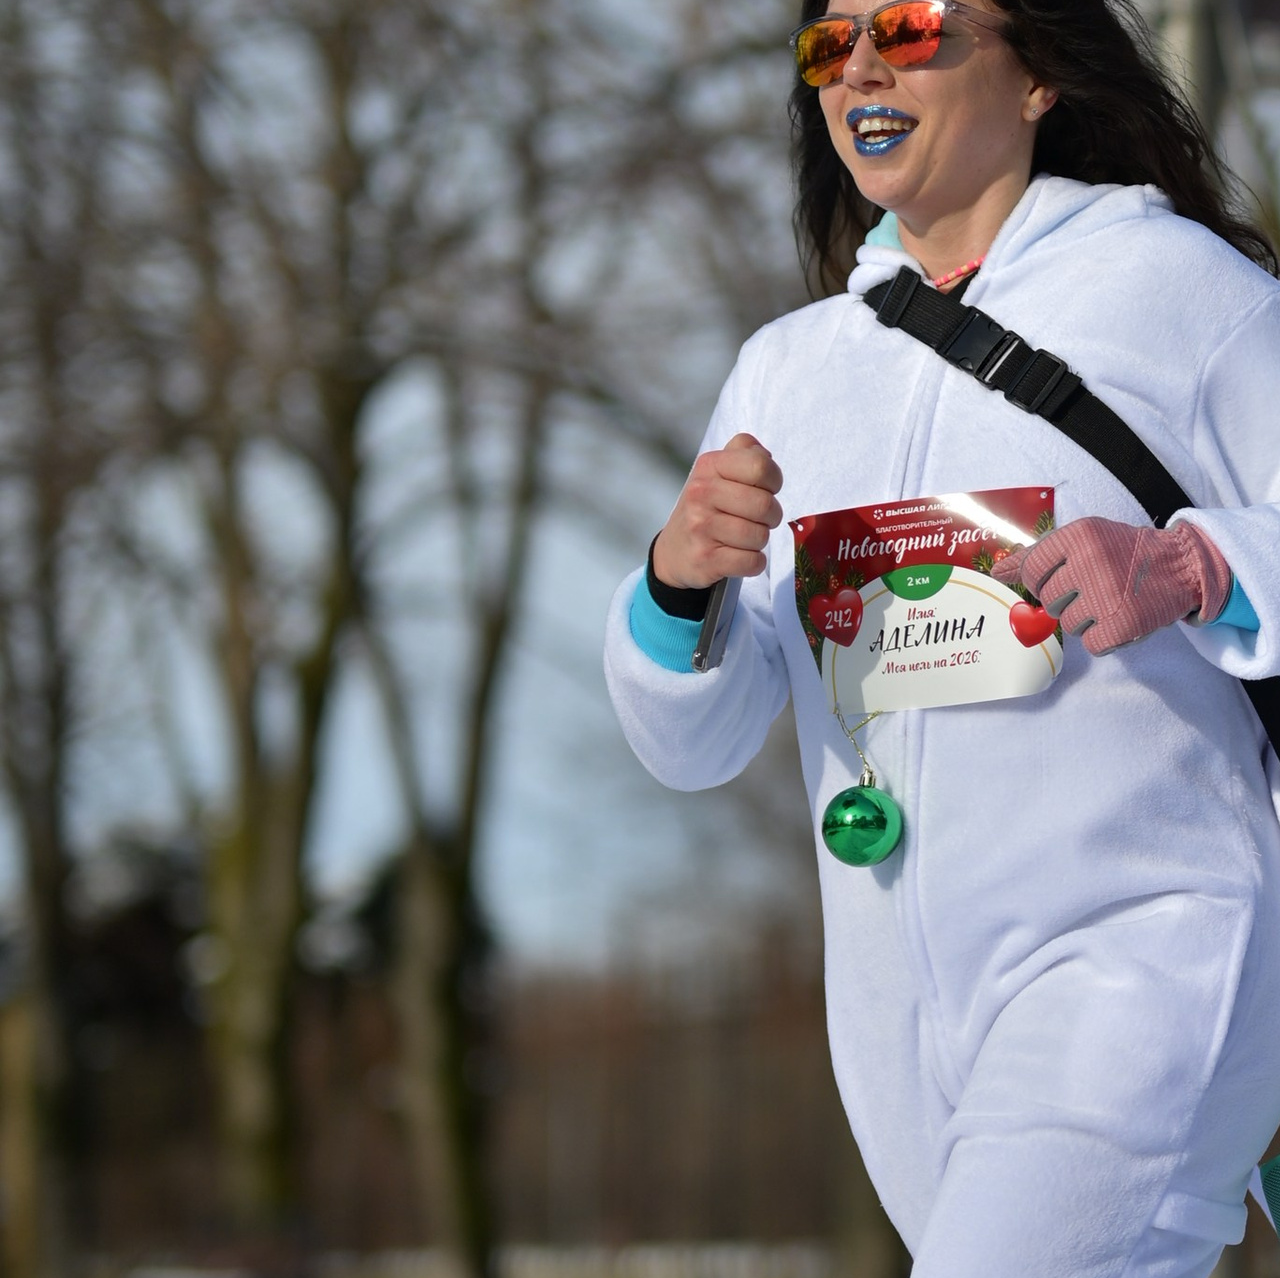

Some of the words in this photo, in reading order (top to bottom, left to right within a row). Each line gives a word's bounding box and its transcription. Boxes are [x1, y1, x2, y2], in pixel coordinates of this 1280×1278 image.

[885, 505, 926, 518] ВЫСШАЯ
[875, 516, 953, 535] БЛАГОТВОРИТЕЛЬНЫЙ
[837, 526, 946, 564] Новогодний
[906, 576, 914, 587] 2
[825, 608, 853, 630] 242
[907, 607, 938, 621] Имя:
[869, 614, 985, 655] АДЕЛИНА
[881, 661, 906, 675] Моя
[908, 660, 932, 672] цель
[933, 658, 948, 668] на
[949, 649, 982, 667] 2026:
